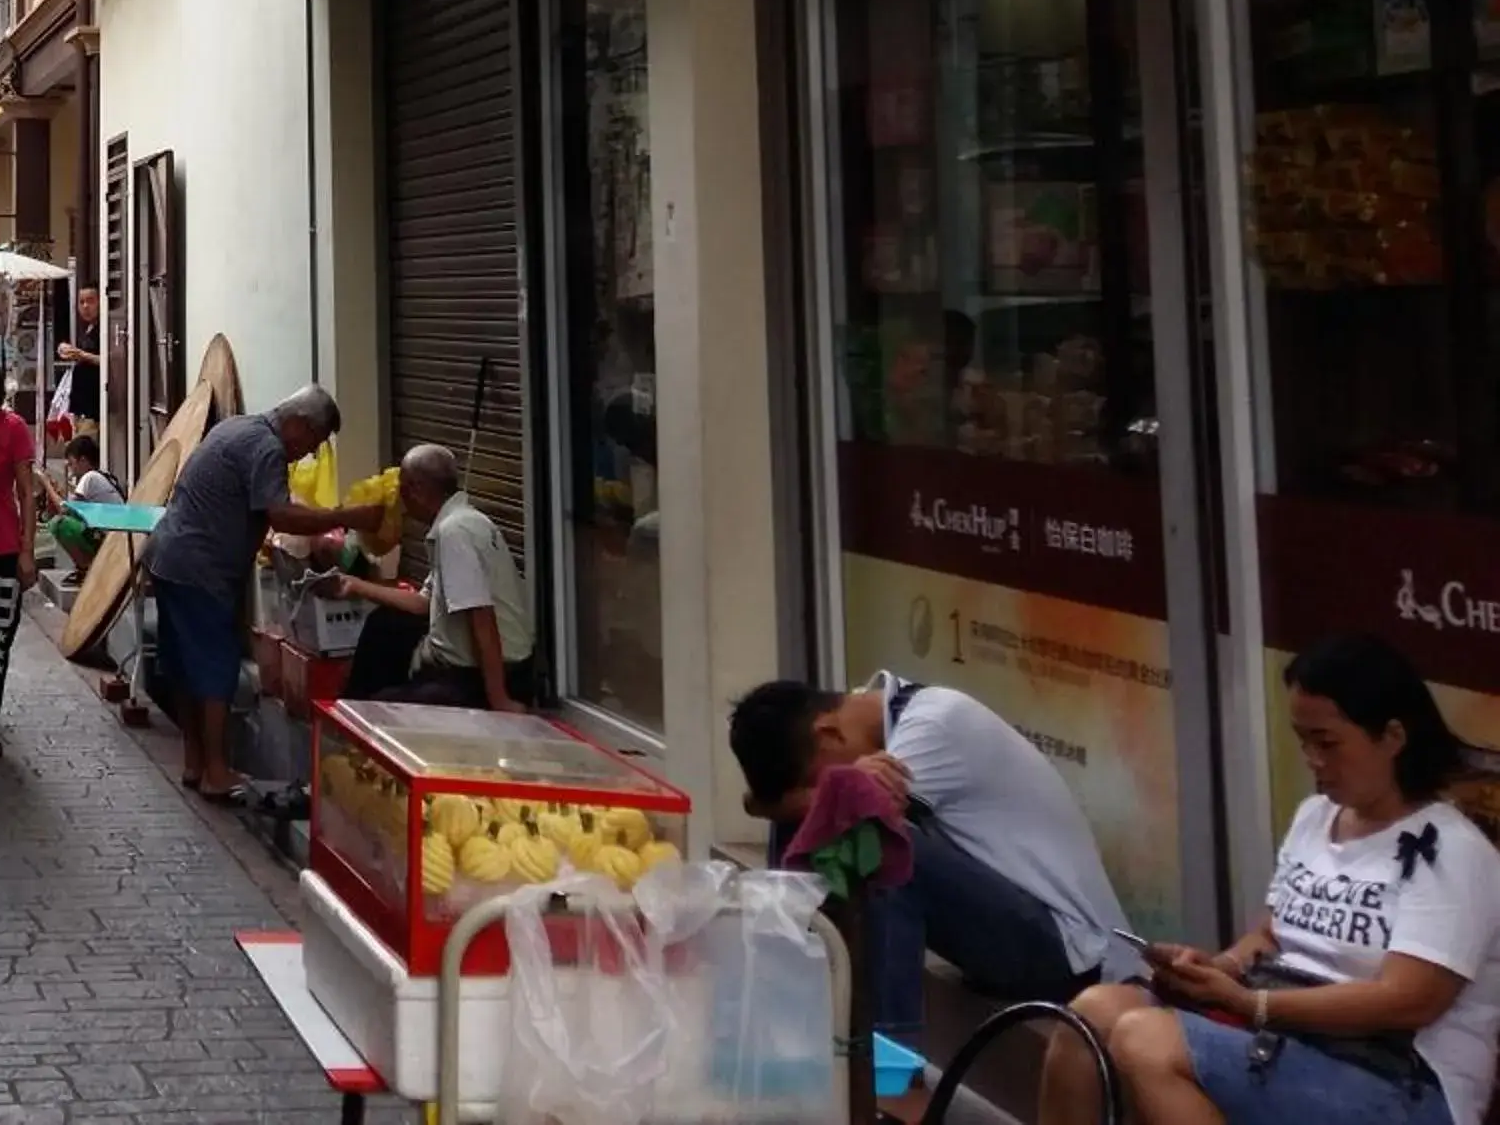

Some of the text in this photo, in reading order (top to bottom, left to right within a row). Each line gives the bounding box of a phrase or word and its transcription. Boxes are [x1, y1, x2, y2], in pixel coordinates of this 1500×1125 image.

[1043, 516, 1136, 562] 怡保白咖啡
